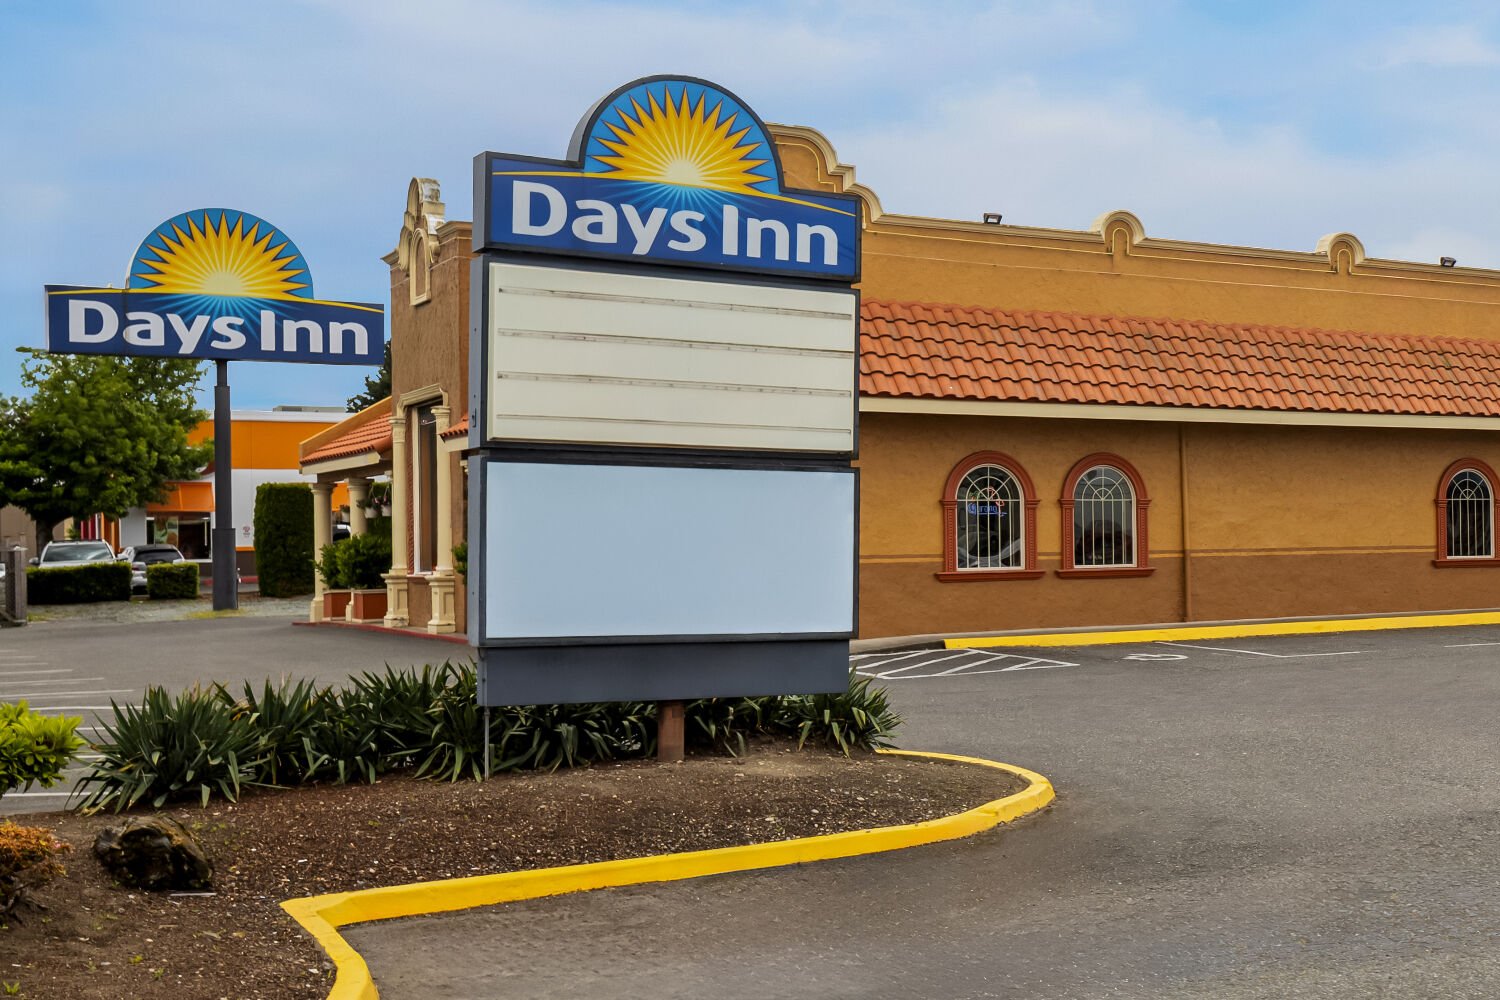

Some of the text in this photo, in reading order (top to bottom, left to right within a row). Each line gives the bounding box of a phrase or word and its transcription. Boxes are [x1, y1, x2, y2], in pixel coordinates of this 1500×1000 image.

[512, 180, 838, 266] Days Inn
[69, 299, 369, 355] Days Inn
